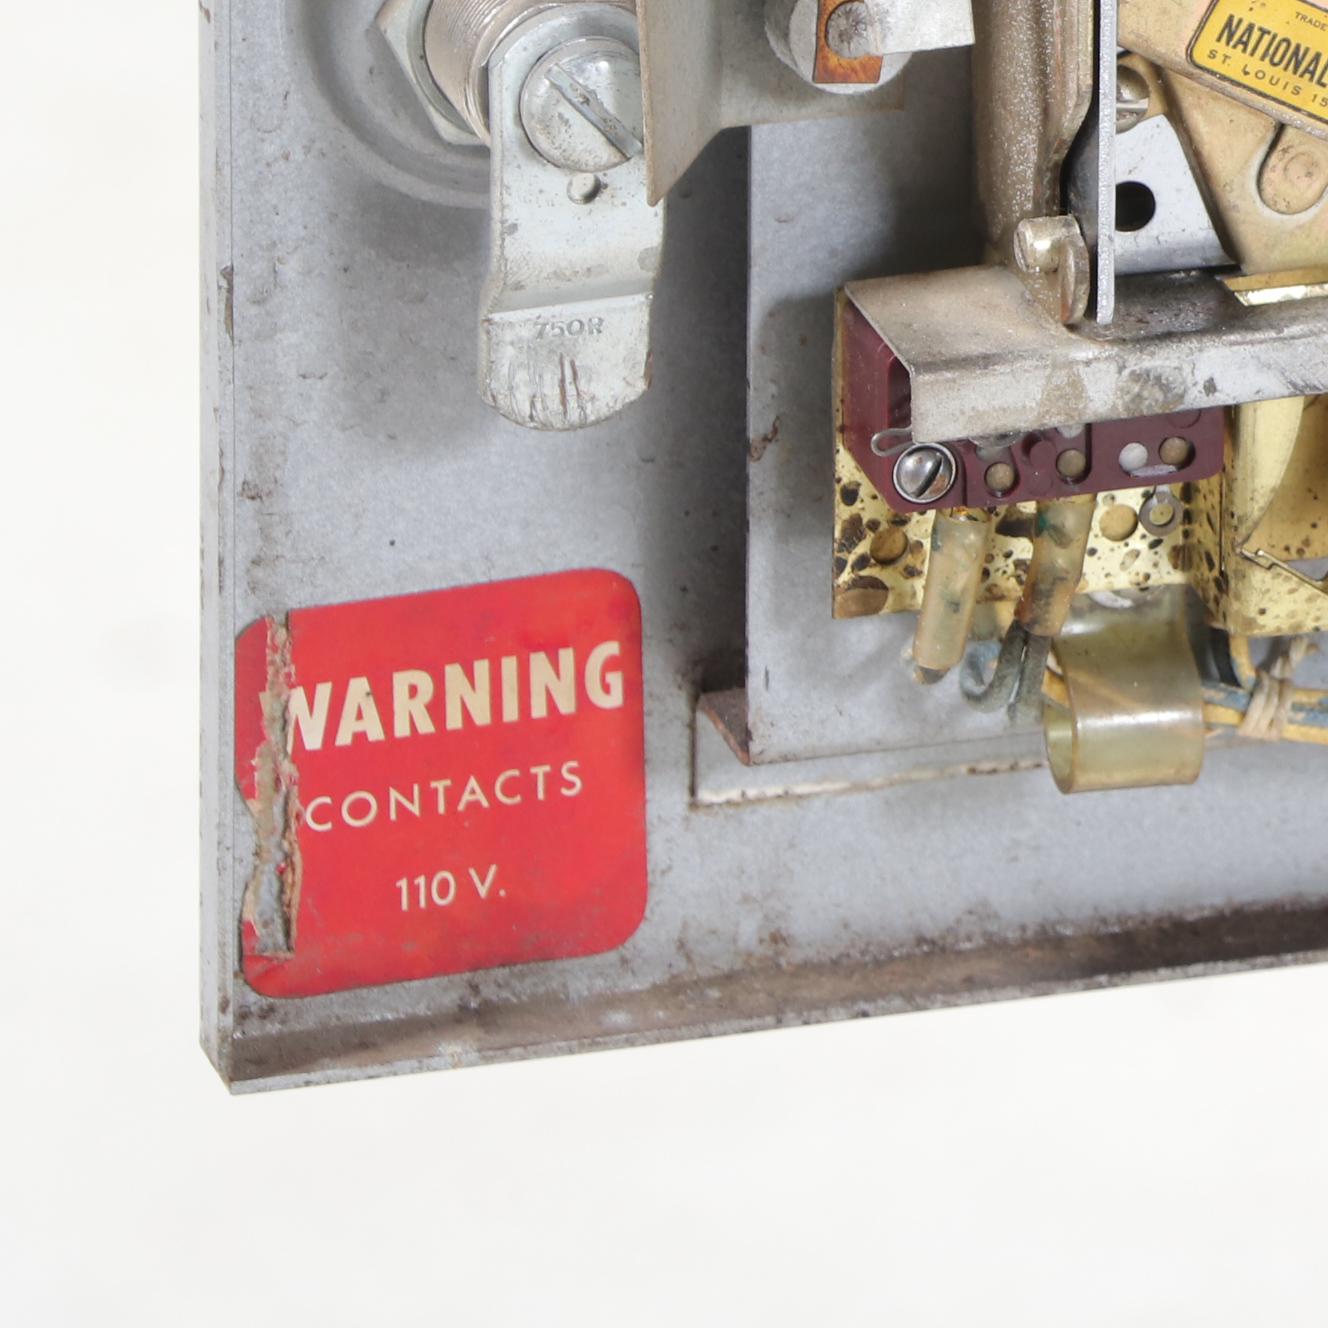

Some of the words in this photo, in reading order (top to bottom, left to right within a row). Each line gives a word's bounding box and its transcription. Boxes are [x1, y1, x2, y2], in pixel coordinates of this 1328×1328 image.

[1295, 12, 1328, 31] TRADE
[1242, 64, 1302, 96] LOUIS
[287, 641, 623, 754] WARNING
[305, 762, 582, 831] CONTACTS
[396, 870, 456, 911] 110
[469, 865, 506, 898] V.
